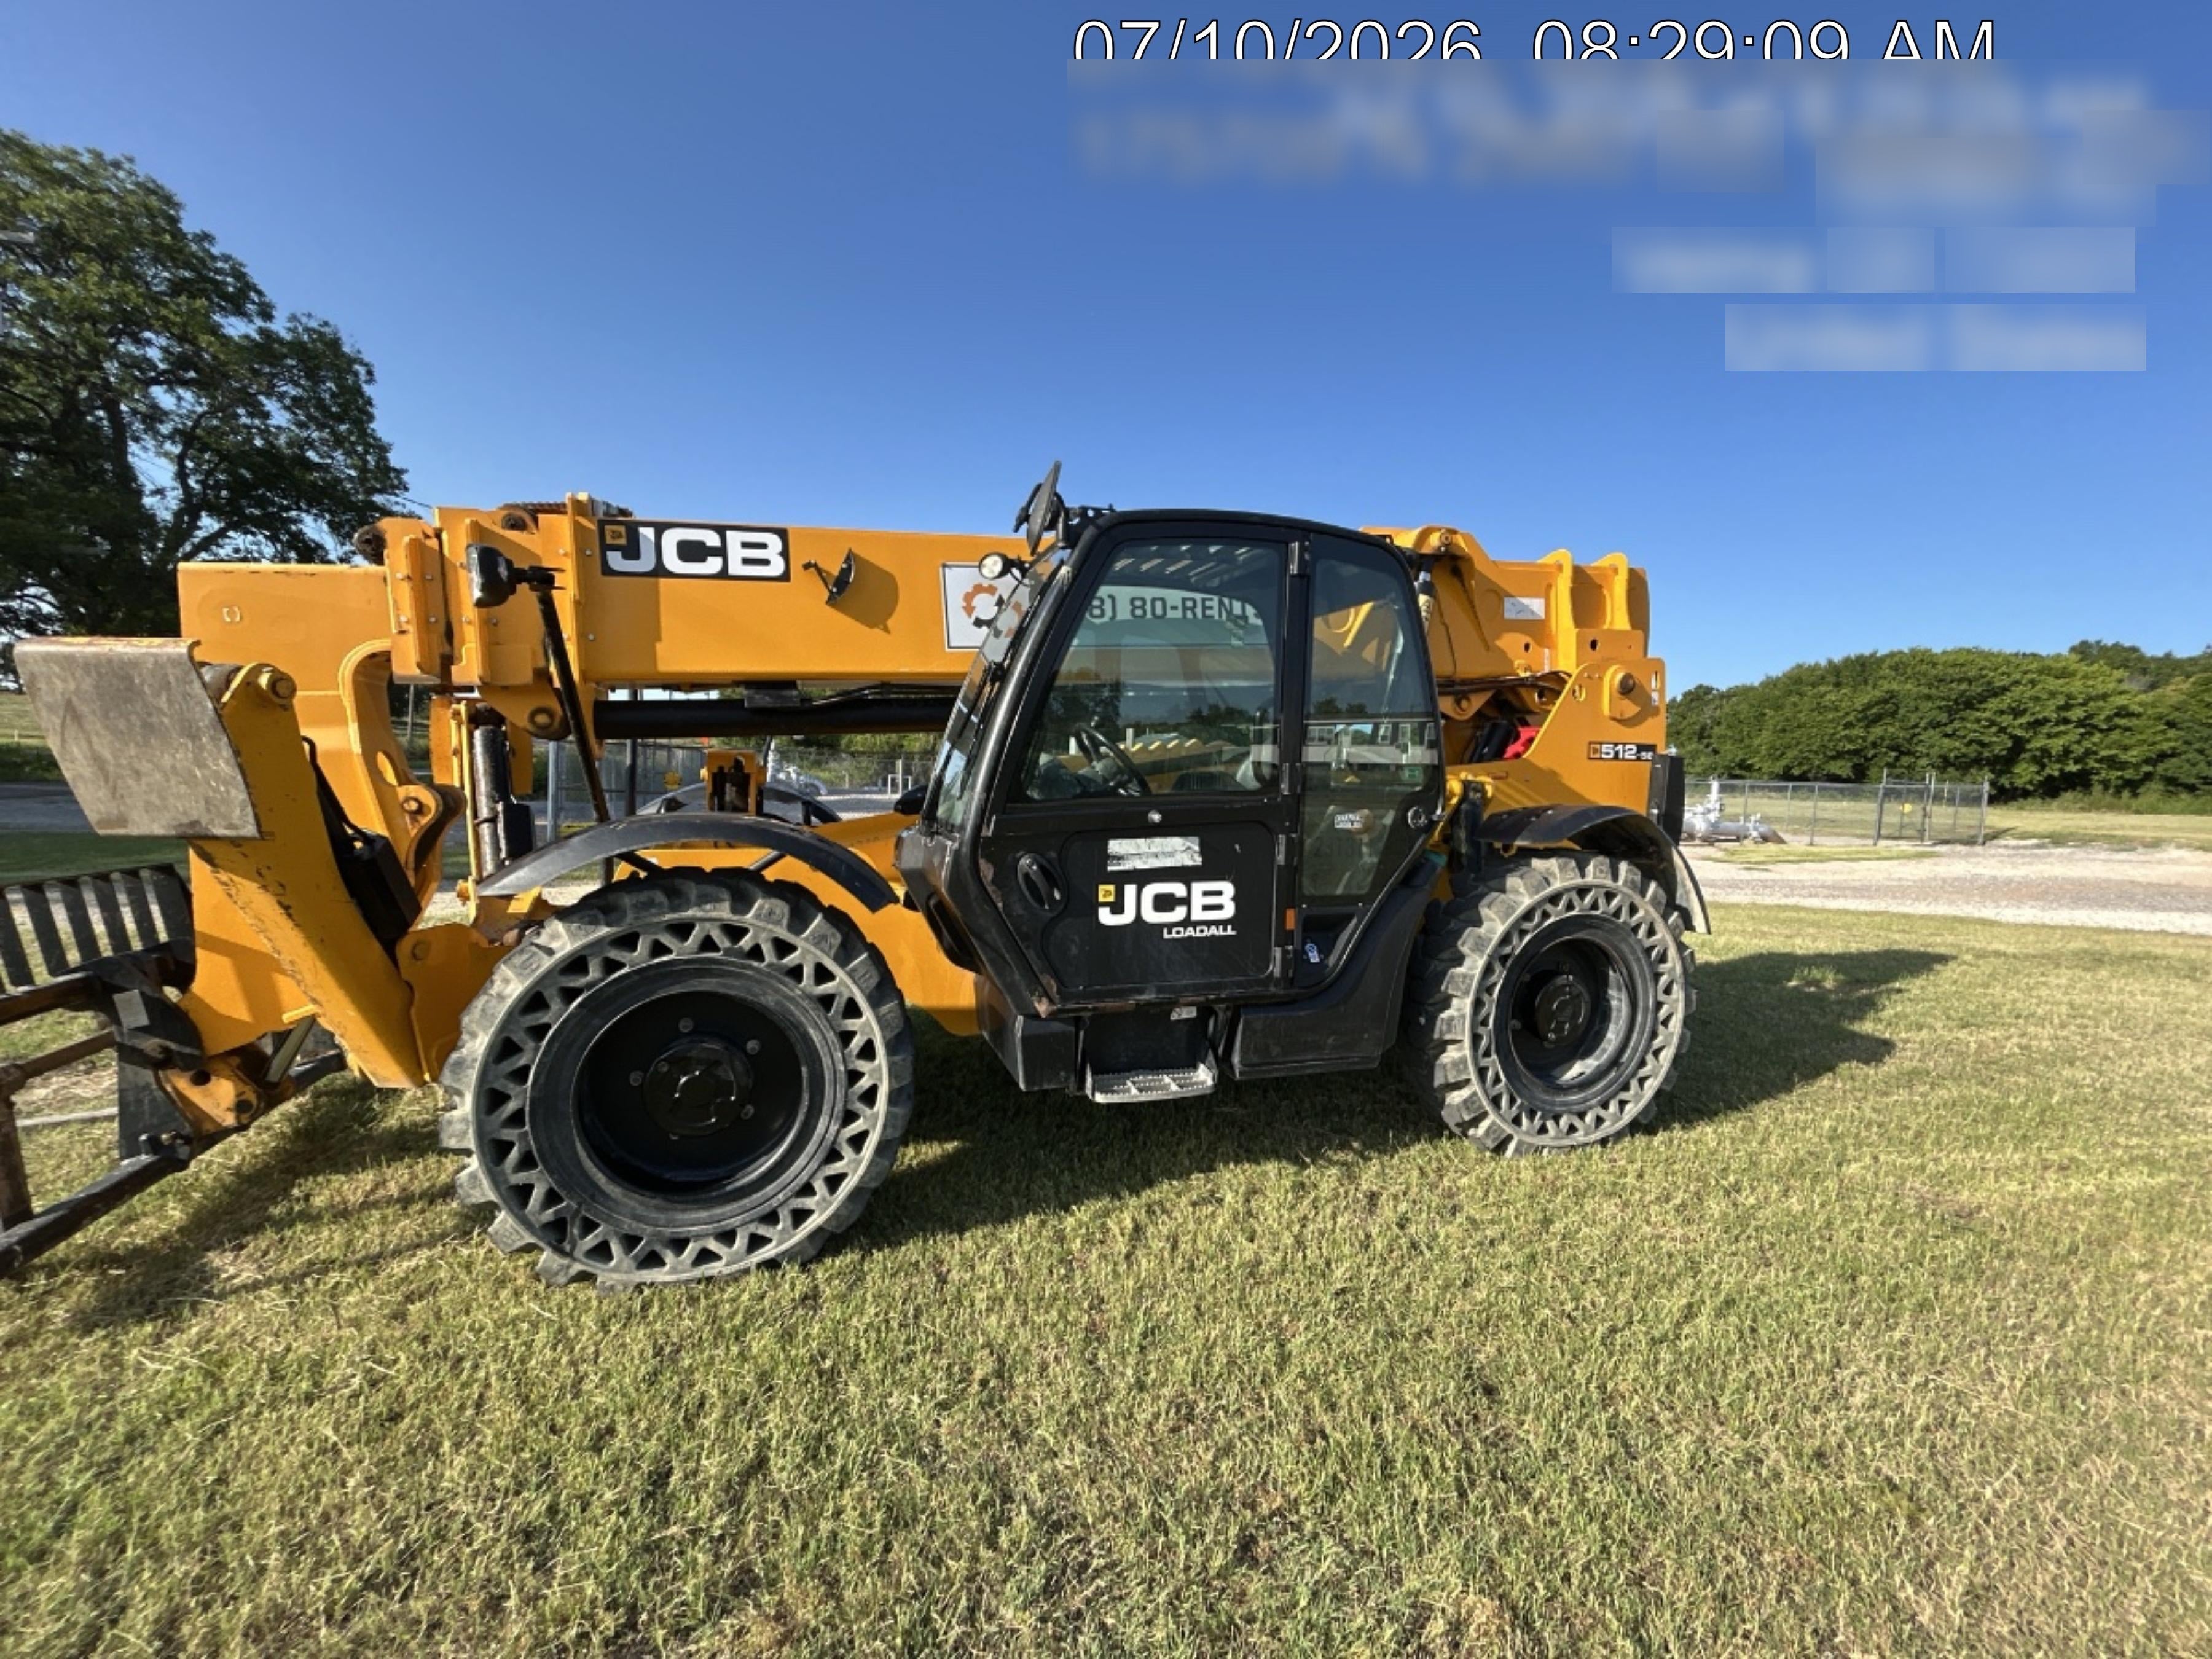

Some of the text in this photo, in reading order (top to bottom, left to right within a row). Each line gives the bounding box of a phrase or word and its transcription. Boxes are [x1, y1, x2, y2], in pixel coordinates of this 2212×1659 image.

[606, 527, 785, 577] JCB
[1098, 880, 1236, 926] JCB
[1163, 925, 1237, 939] LOADALL
